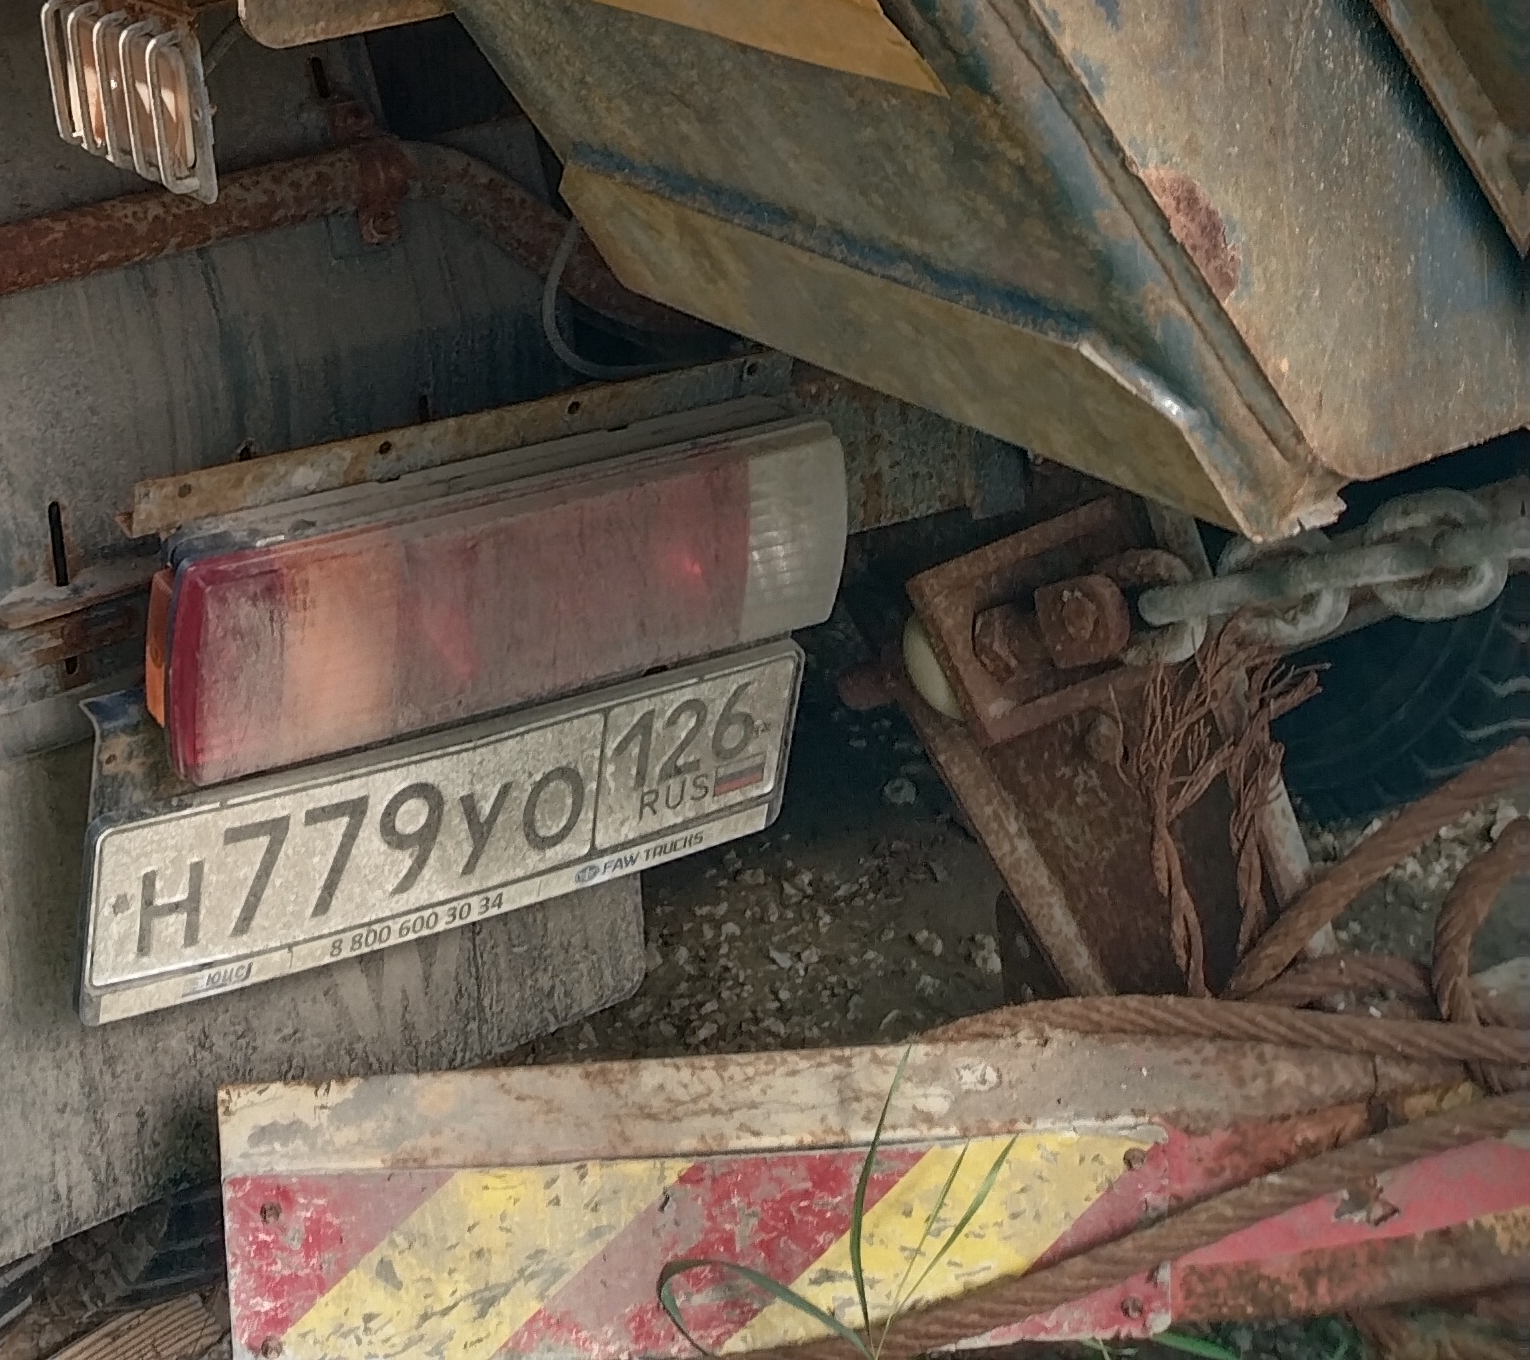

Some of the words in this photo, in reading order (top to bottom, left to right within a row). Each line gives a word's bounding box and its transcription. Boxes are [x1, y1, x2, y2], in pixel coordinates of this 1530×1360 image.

[610, 680, 756, 791] 126
[638, 773, 710, 824] RUS
[602, 850, 641, 876] FAW
[643, 830, 704, 862] TRUCKS
[329, 937, 343, 959] 8
[349, 924, 392, 953] 800
[398, 911, 439, 940] 600
[444, 902, 473, 926] 30
[477, 891, 505, 919] 34
